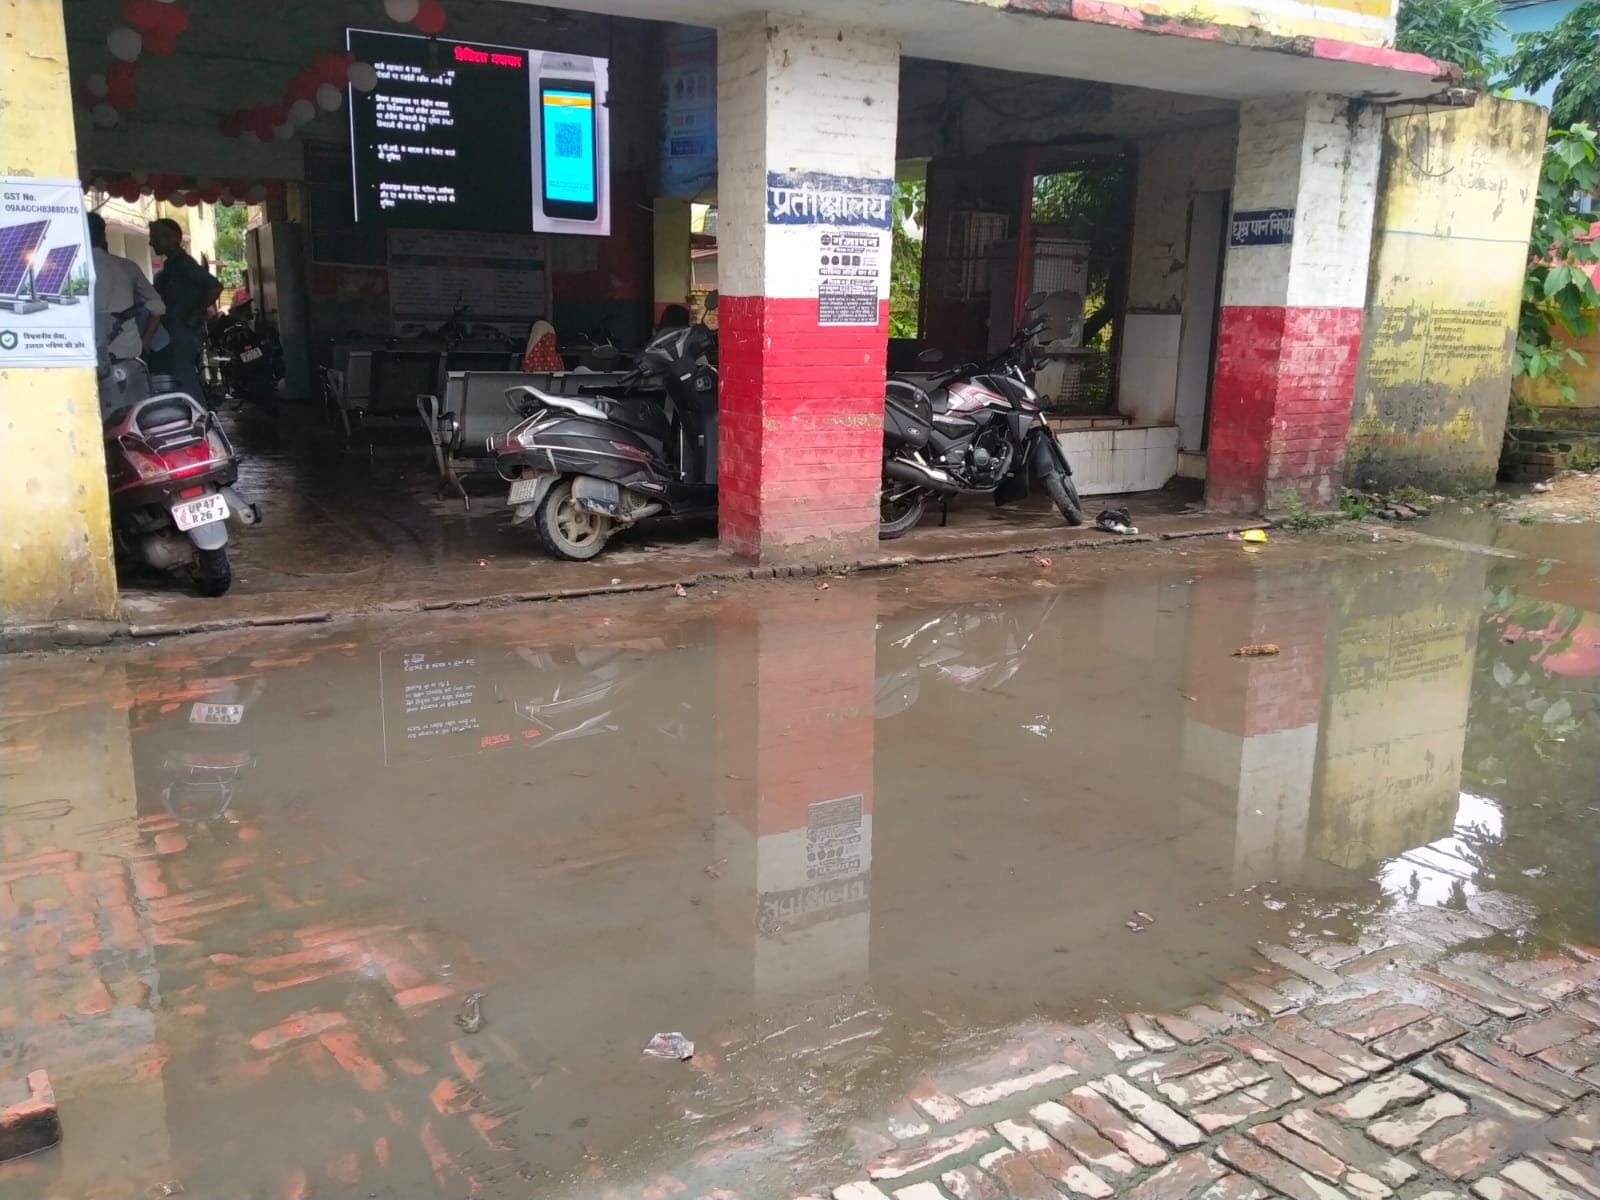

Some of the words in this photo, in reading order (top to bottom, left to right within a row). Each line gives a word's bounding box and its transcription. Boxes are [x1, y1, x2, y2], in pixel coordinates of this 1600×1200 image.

[4, 192, 20, 201] GST
[23, 193, 37, 201] No.
[769, 184, 889, 221] प्रतीक्षालय
